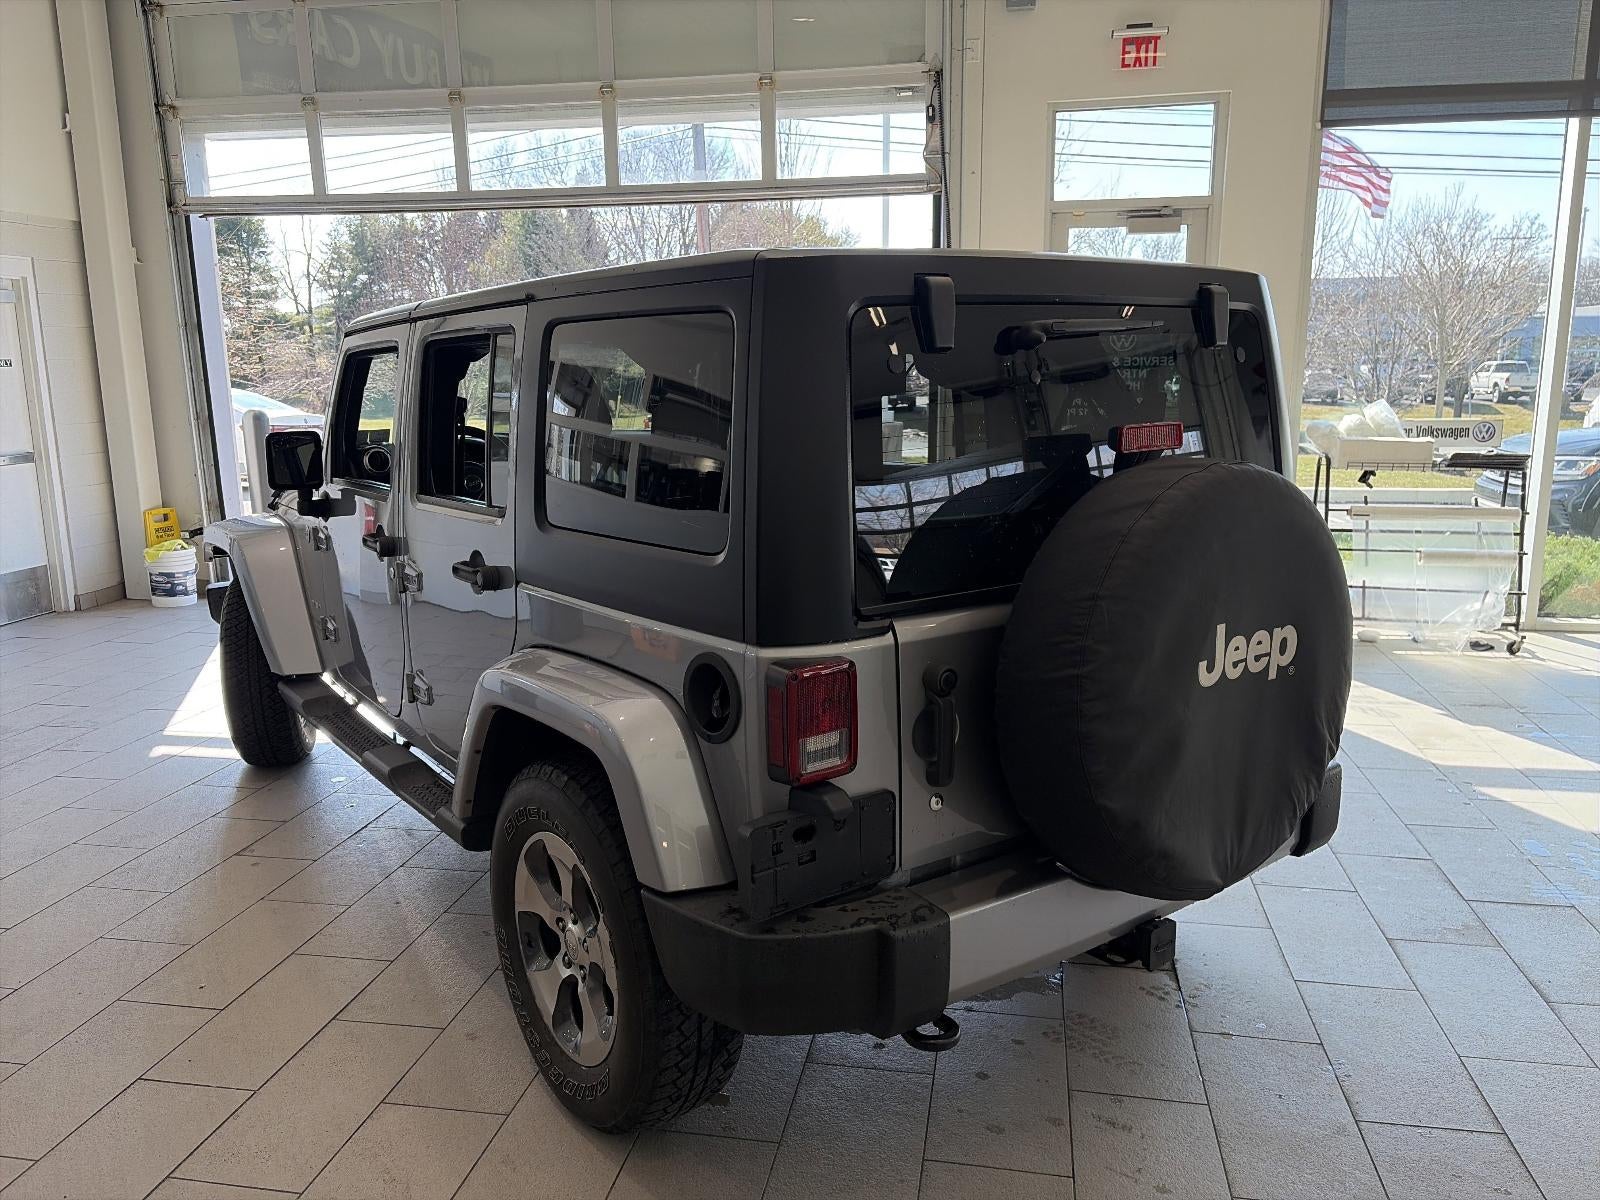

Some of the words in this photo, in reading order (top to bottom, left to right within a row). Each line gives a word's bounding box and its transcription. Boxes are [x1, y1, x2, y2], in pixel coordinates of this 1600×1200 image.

[1120, 35, 1161, 69] EXIT
[1416, 425, 1470, 440] Volkswagen
[1198, 622, 1298, 688] Jeep
